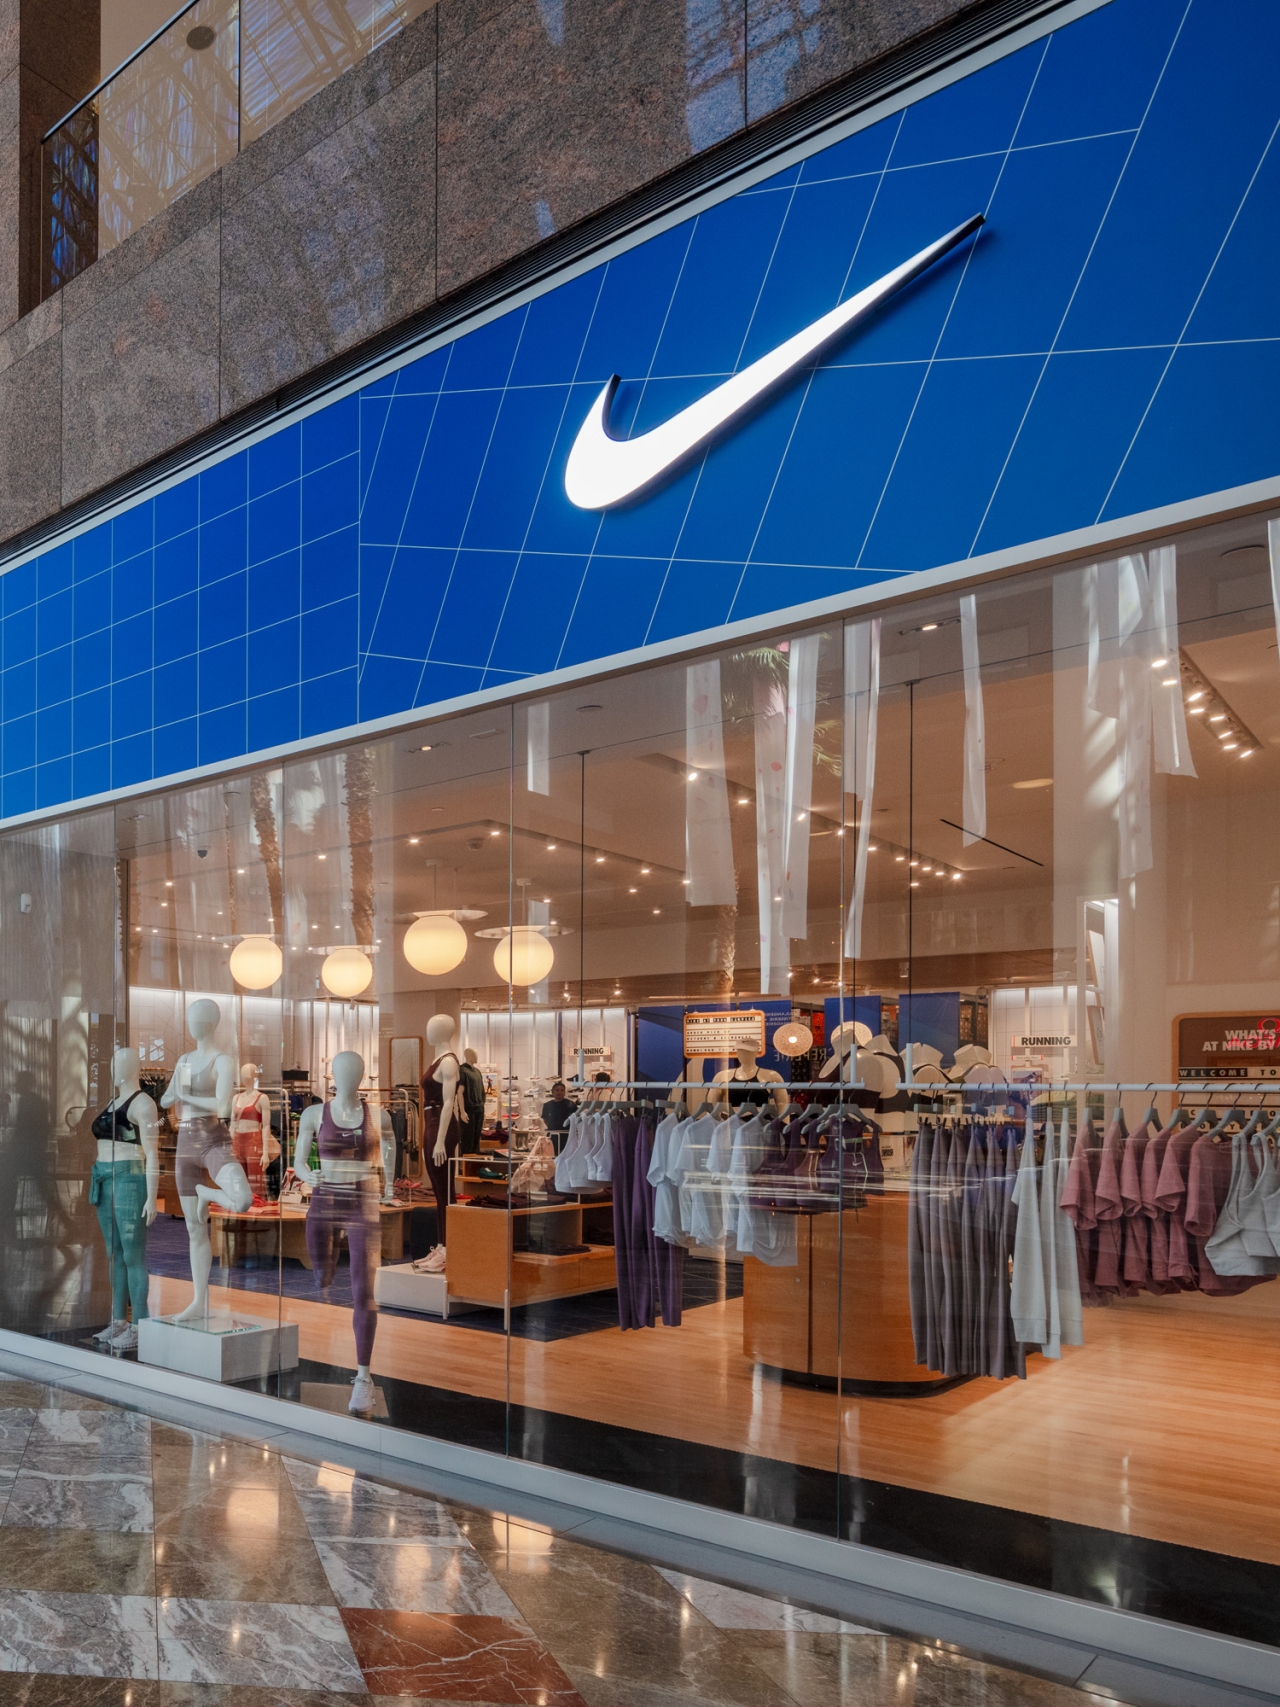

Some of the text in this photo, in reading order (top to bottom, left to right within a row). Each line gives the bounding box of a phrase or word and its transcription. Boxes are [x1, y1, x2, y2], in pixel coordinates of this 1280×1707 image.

[1021, 1036, 1071, 1046] RUNNING
[1202, 1040, 1276, 1052] AT NIKE BY
[573, 1047, 604, 1055] RNNING
[1179, 1069, 1246, 1077] WELCOME
